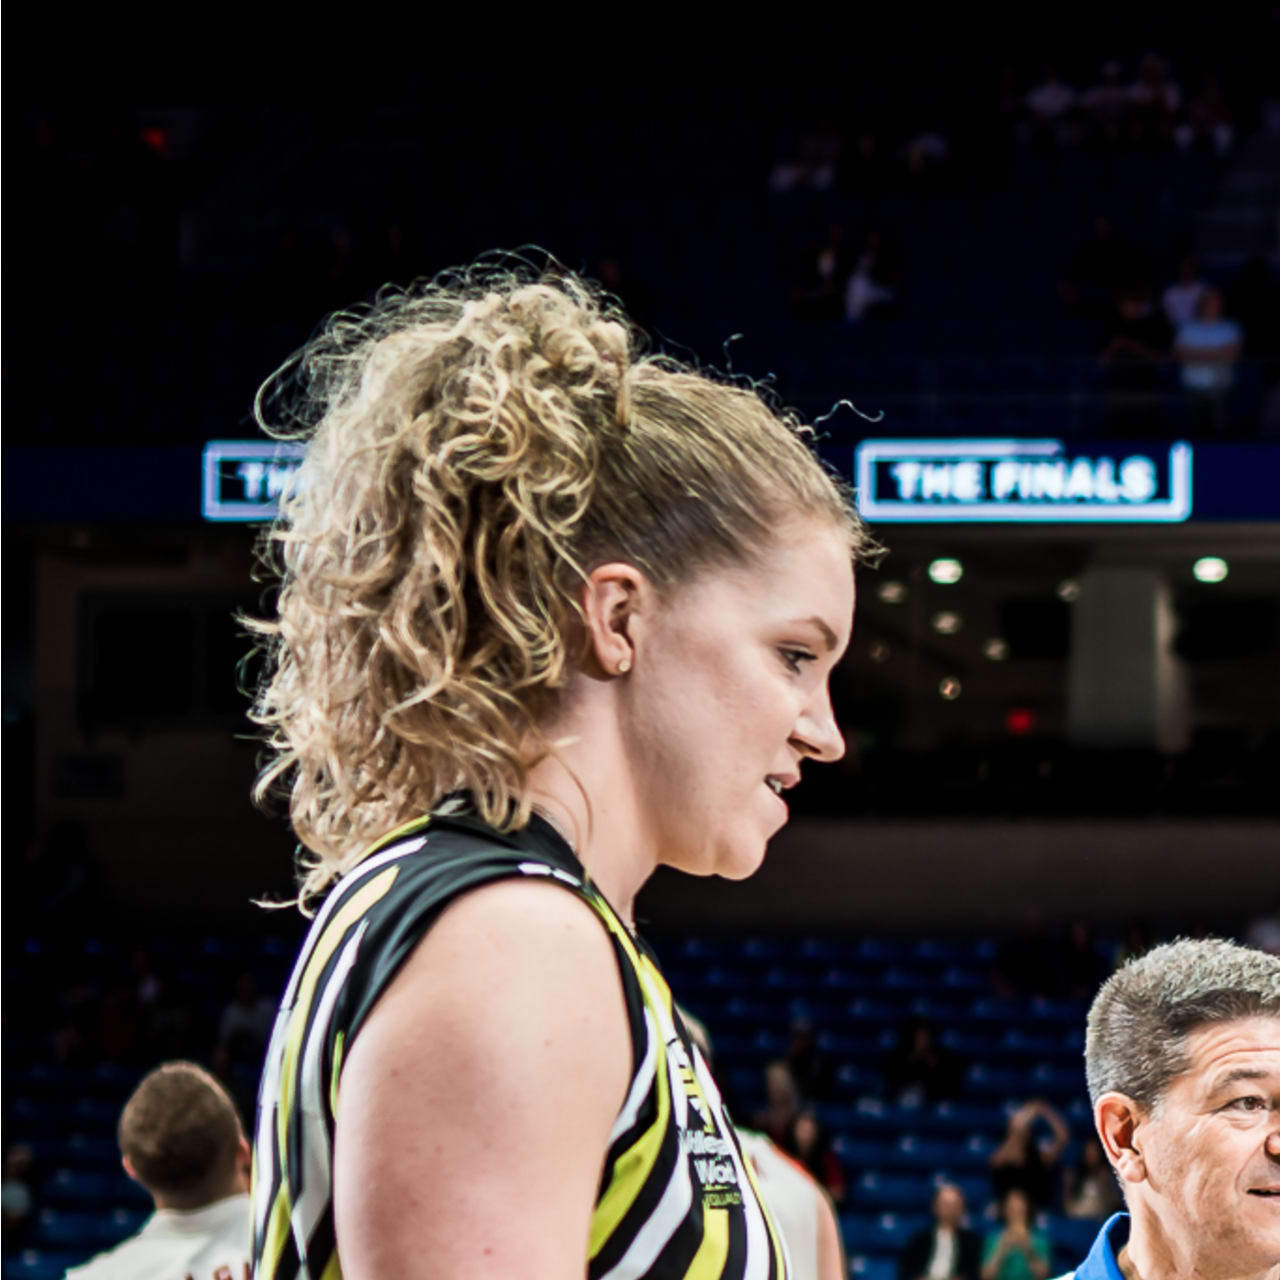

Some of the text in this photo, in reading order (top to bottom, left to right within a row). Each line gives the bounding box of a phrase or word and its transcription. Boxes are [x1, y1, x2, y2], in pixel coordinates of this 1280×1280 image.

[239, 461, 299, 499] TH
[892, 455, 1156, 502] THE FINALS
